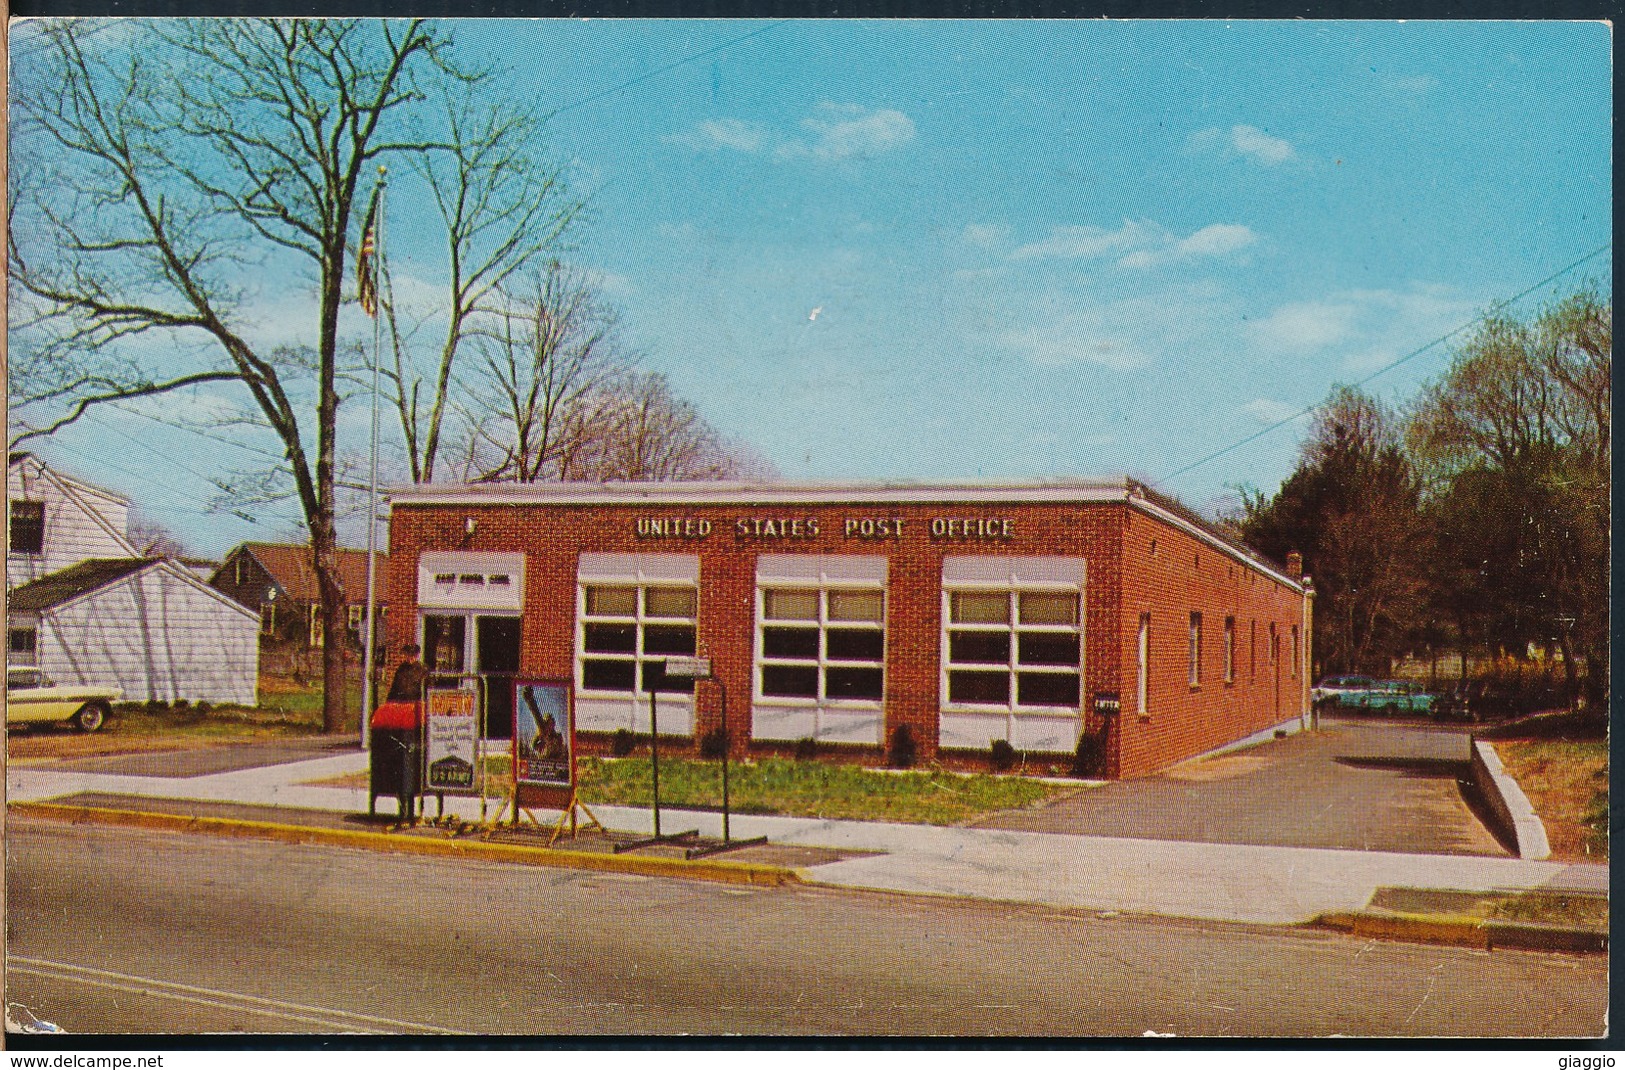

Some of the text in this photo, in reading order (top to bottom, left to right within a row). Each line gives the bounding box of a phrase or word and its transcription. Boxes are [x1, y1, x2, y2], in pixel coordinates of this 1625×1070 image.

[638, 518, 1015, 537] UNITED STATES POST OFFICE
[431, 693, 474, 716] NEW
